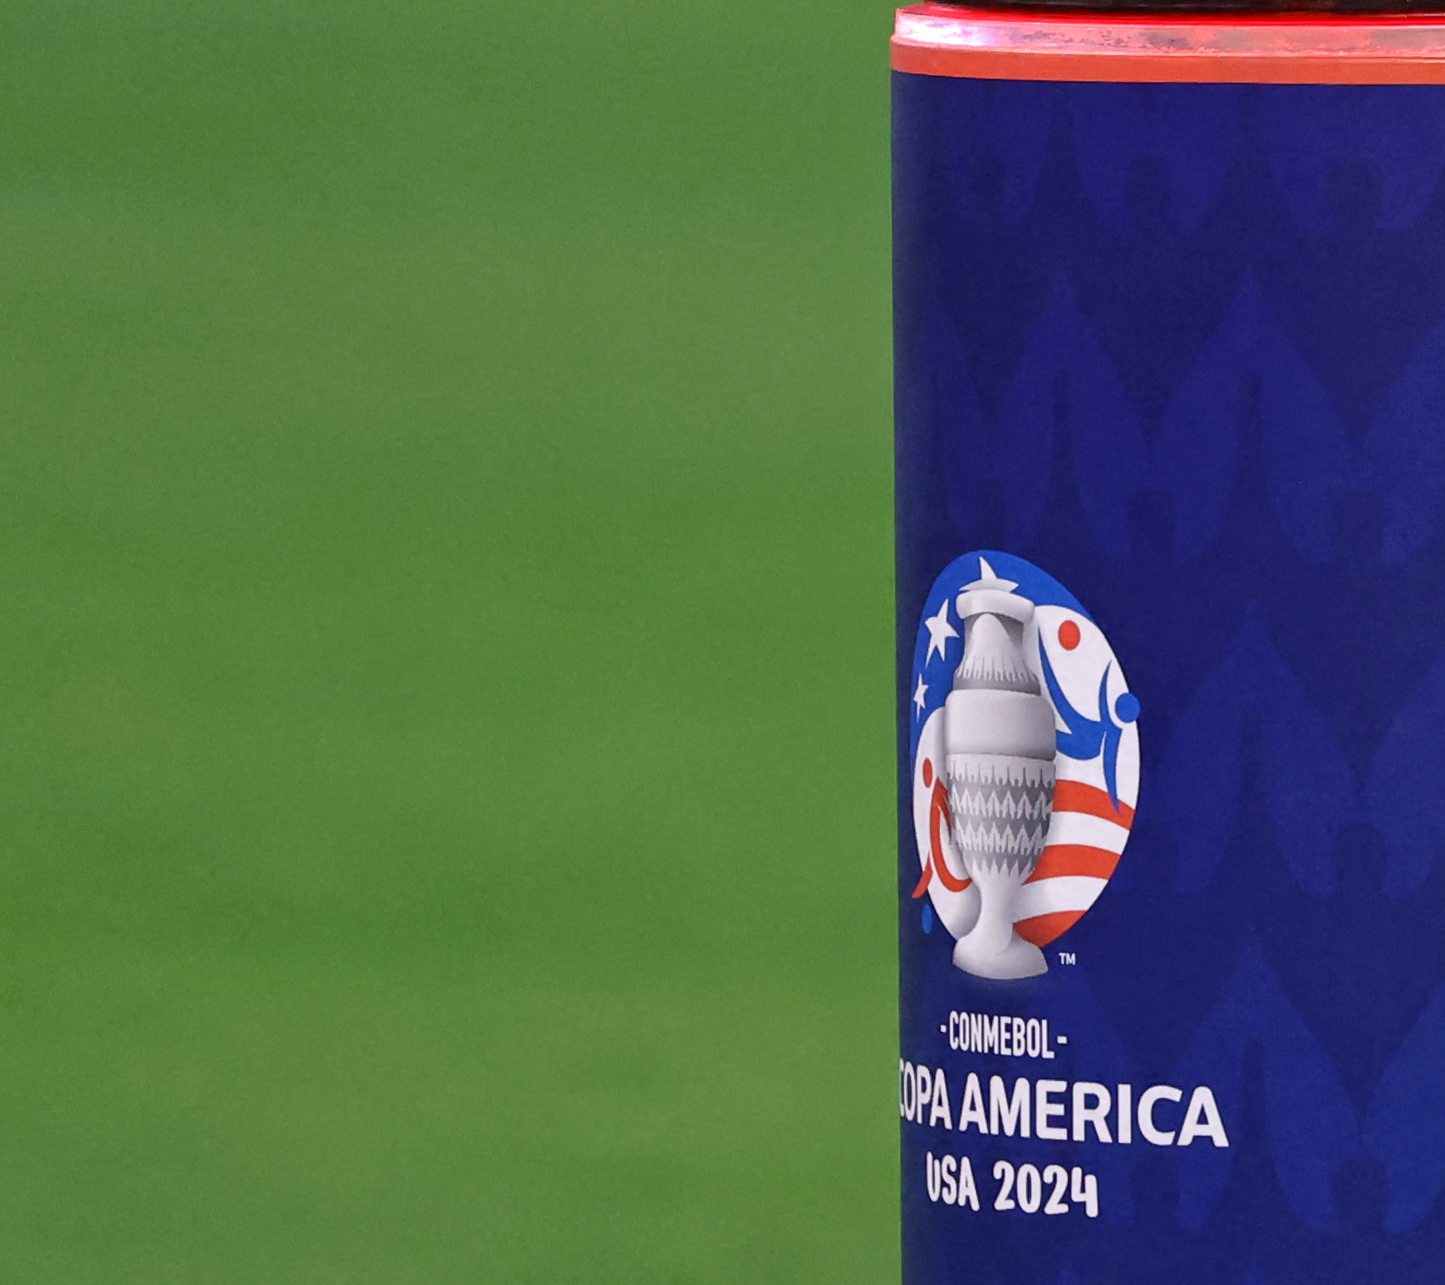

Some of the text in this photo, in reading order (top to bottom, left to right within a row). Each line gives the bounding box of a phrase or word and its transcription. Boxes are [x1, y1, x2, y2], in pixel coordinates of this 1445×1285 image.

[1059, 952, 1076, 965] TM
[958, 1072, 1230, 1148] AMERICA
[926, 1151, 1099, 1218] USA 2024
